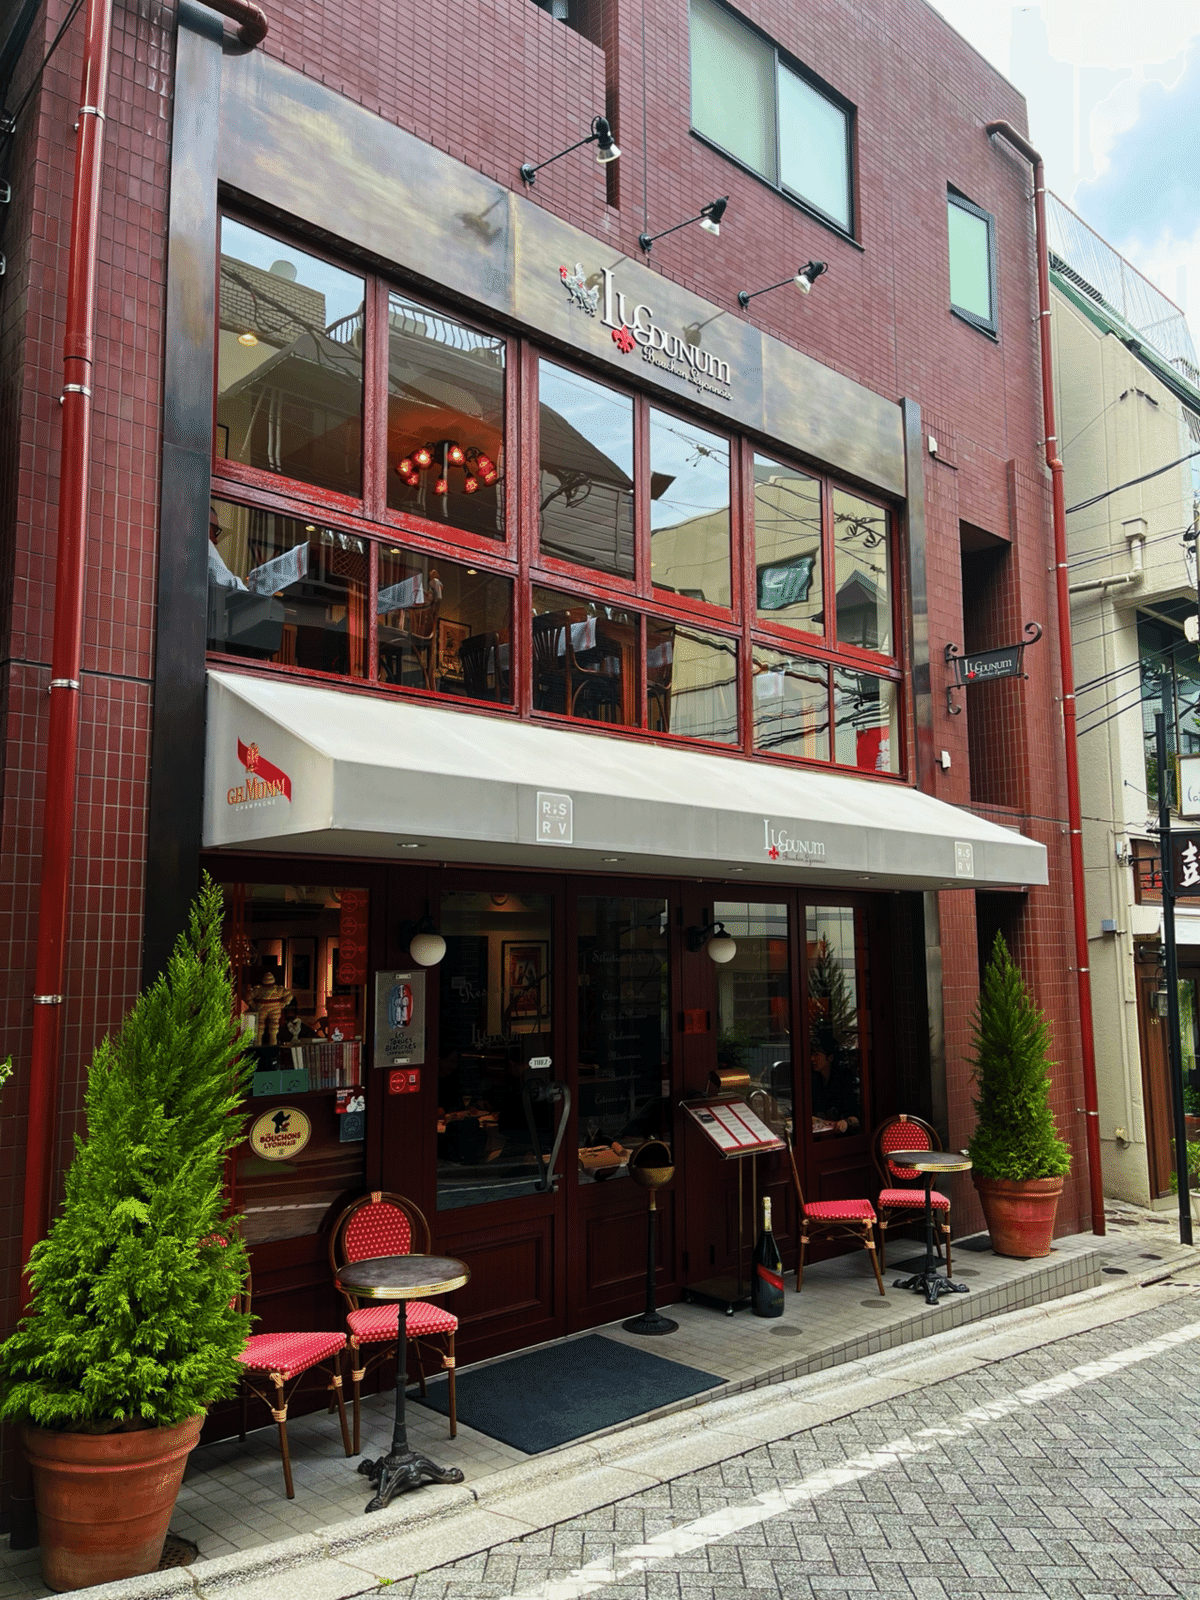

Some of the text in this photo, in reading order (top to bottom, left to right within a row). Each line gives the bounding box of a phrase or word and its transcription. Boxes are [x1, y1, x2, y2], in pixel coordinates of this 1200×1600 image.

[642, 346, 688, 379] Bouchon
[235, 799, 276, 812] CHAMPAGNE
[259, 1131, 301, 1144] BOUCHONS
[263, 1139, 296, 1149] LYONNAIS
